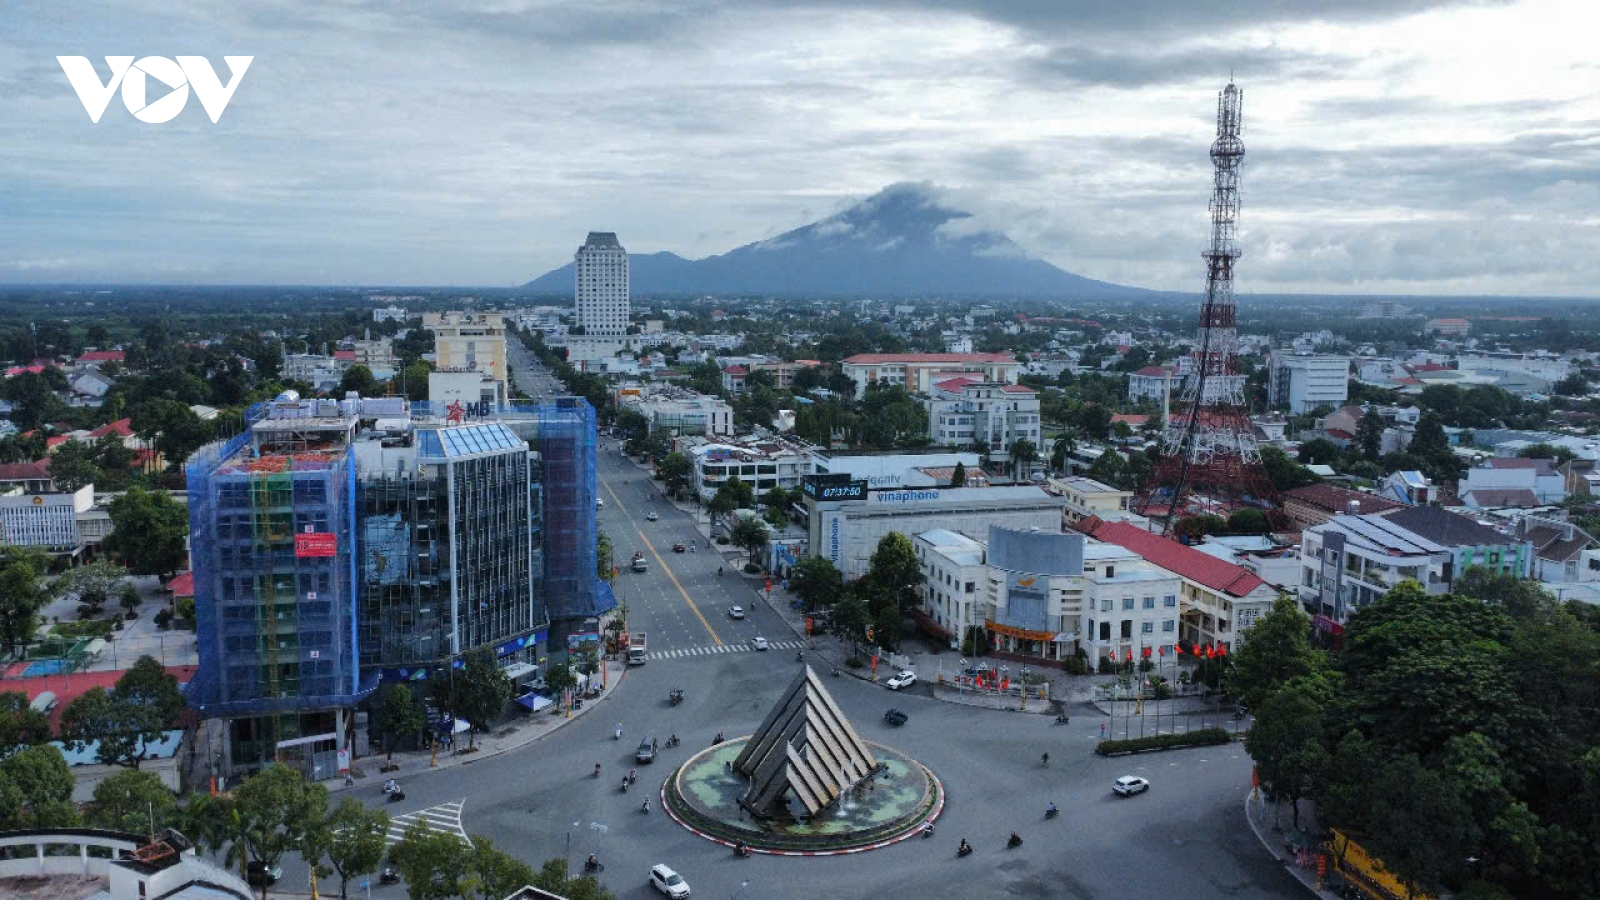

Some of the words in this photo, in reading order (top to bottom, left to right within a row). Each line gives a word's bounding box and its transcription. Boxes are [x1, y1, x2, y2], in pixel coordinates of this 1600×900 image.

[467, 401, 490, 417] MB
[877, 490, 940, 503] vinaphone
[831, 517, 839, 561] vinaphone
